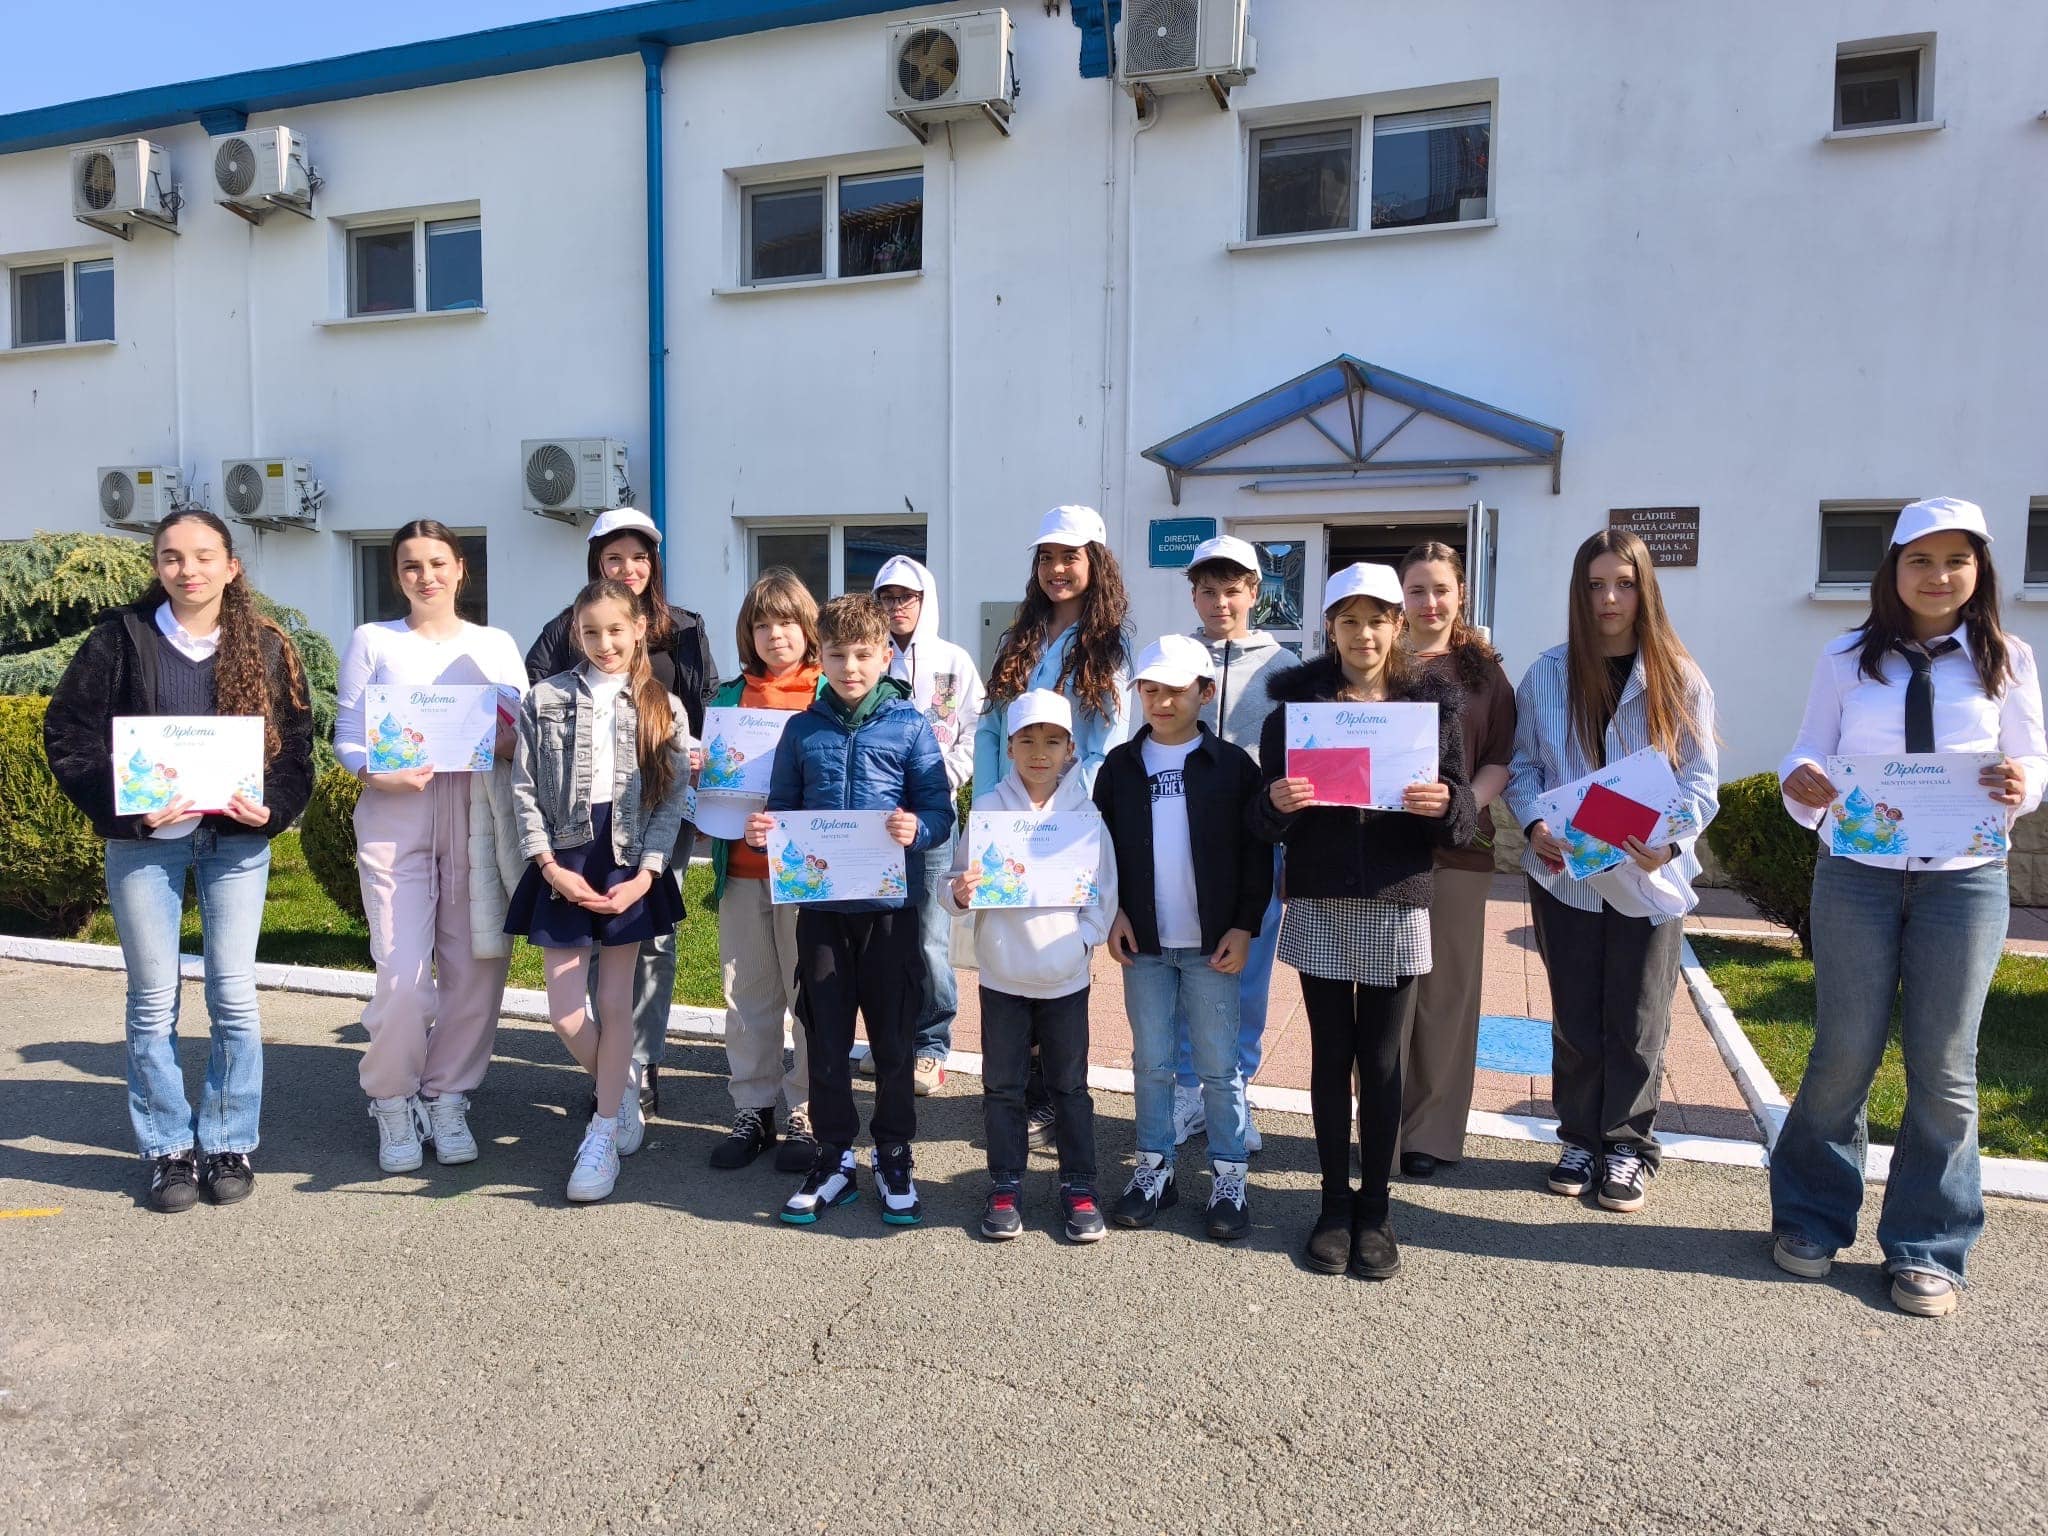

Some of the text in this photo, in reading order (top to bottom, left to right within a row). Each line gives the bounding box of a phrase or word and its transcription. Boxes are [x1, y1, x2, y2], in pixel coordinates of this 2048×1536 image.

[1660, 522, 1697, 530] CAPITAL
[1655, 532, 1695, 541] PROPRIE
[1660, 554, 1683, 562] 2010
[410, 692, 457, 706] Diploma
[739, 714, 780, 728] Diploma
[1335, 711, 1388, 727] Diploma
[162, 725, 216, 739] Diploma
[1884, 761, 1945, 777] Diploma
[1157, 771, 1182, 783] VANS
[1159, 781, 1178, 795] THE
[810, 817, 857, 832] Diploma
[1013, 819, 1059, 835] Diploma
